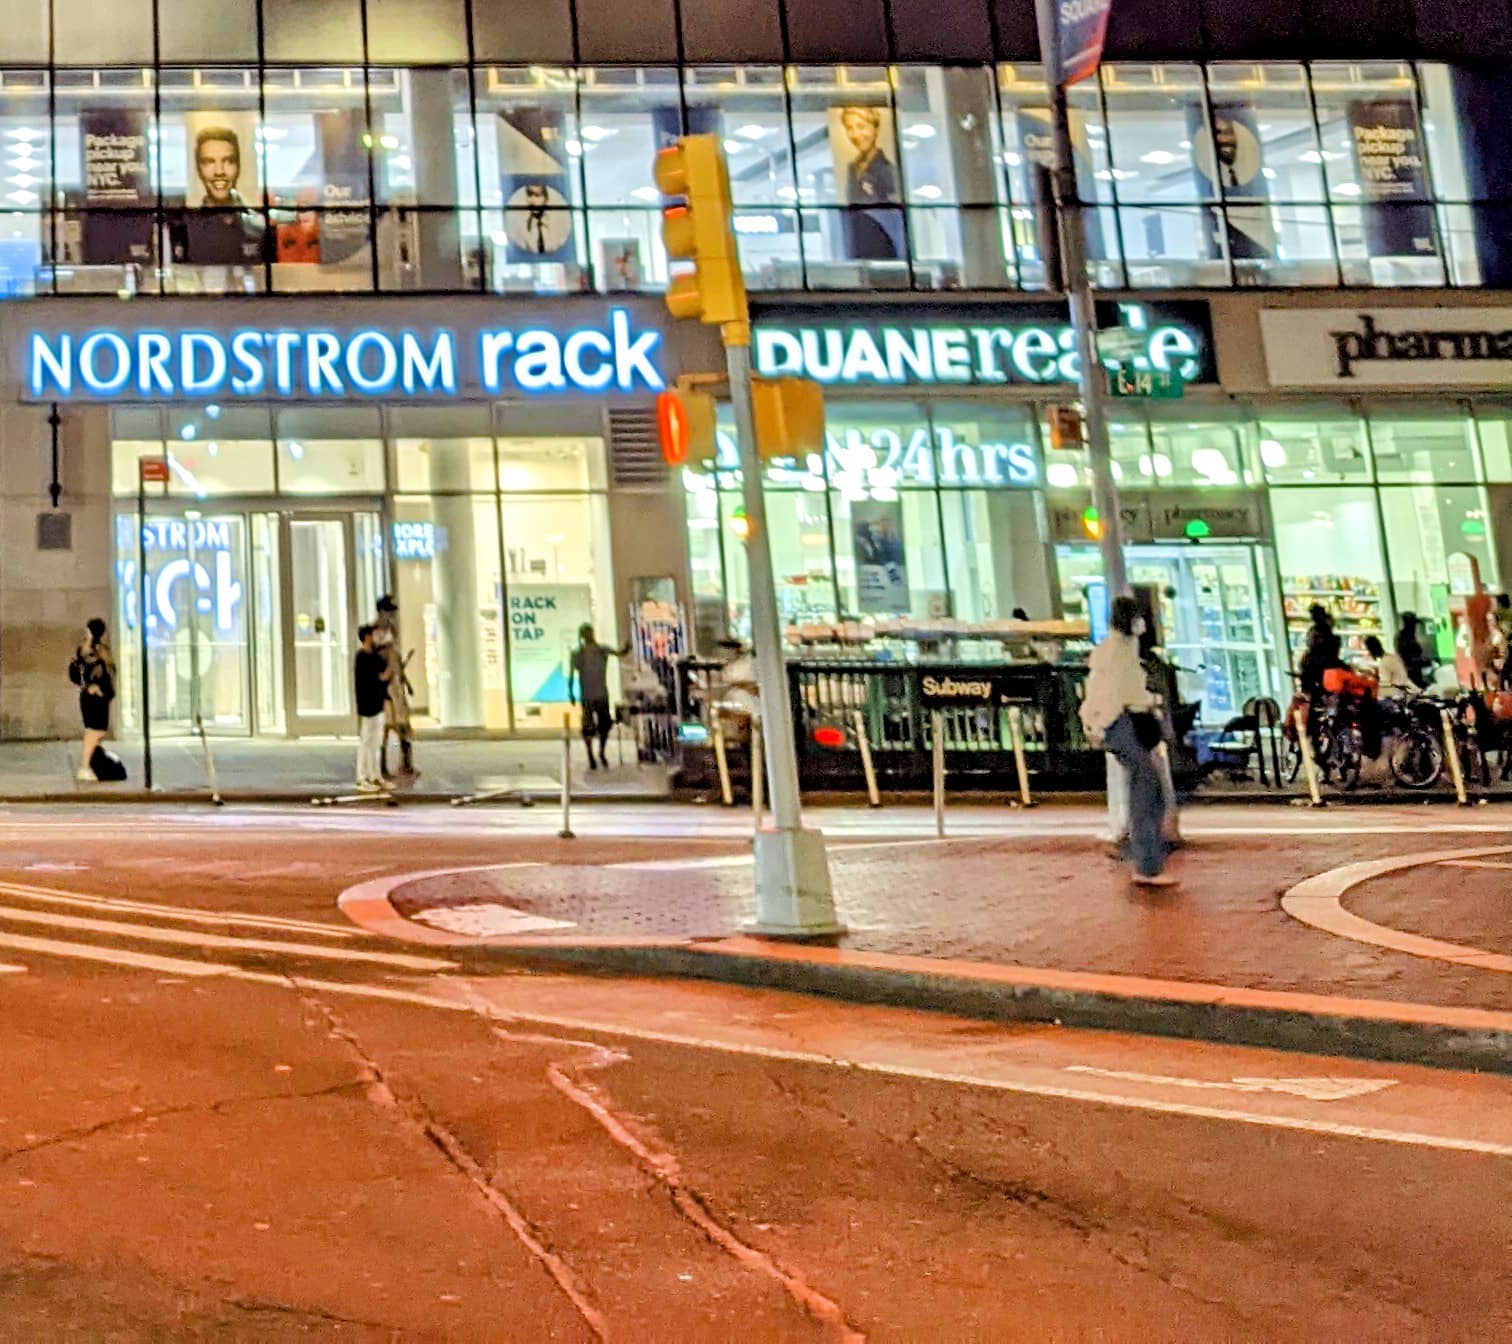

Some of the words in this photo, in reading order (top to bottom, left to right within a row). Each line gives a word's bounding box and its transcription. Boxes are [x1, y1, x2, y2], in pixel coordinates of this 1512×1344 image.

[32, 331, 456, 394] NORDSTROM
[482, 310, 665, 391] rack
[1118, 369, 1130, 395] E
[1136, 372, 1152, 395] 14
[873, 428, 1037, 485] 24hrs
[510, 596, 556, 609] RACK
[512, 612, 536, 625] ON
[513, 628, 544, 641] TAP
[922, 675, 992, 699] Subway
